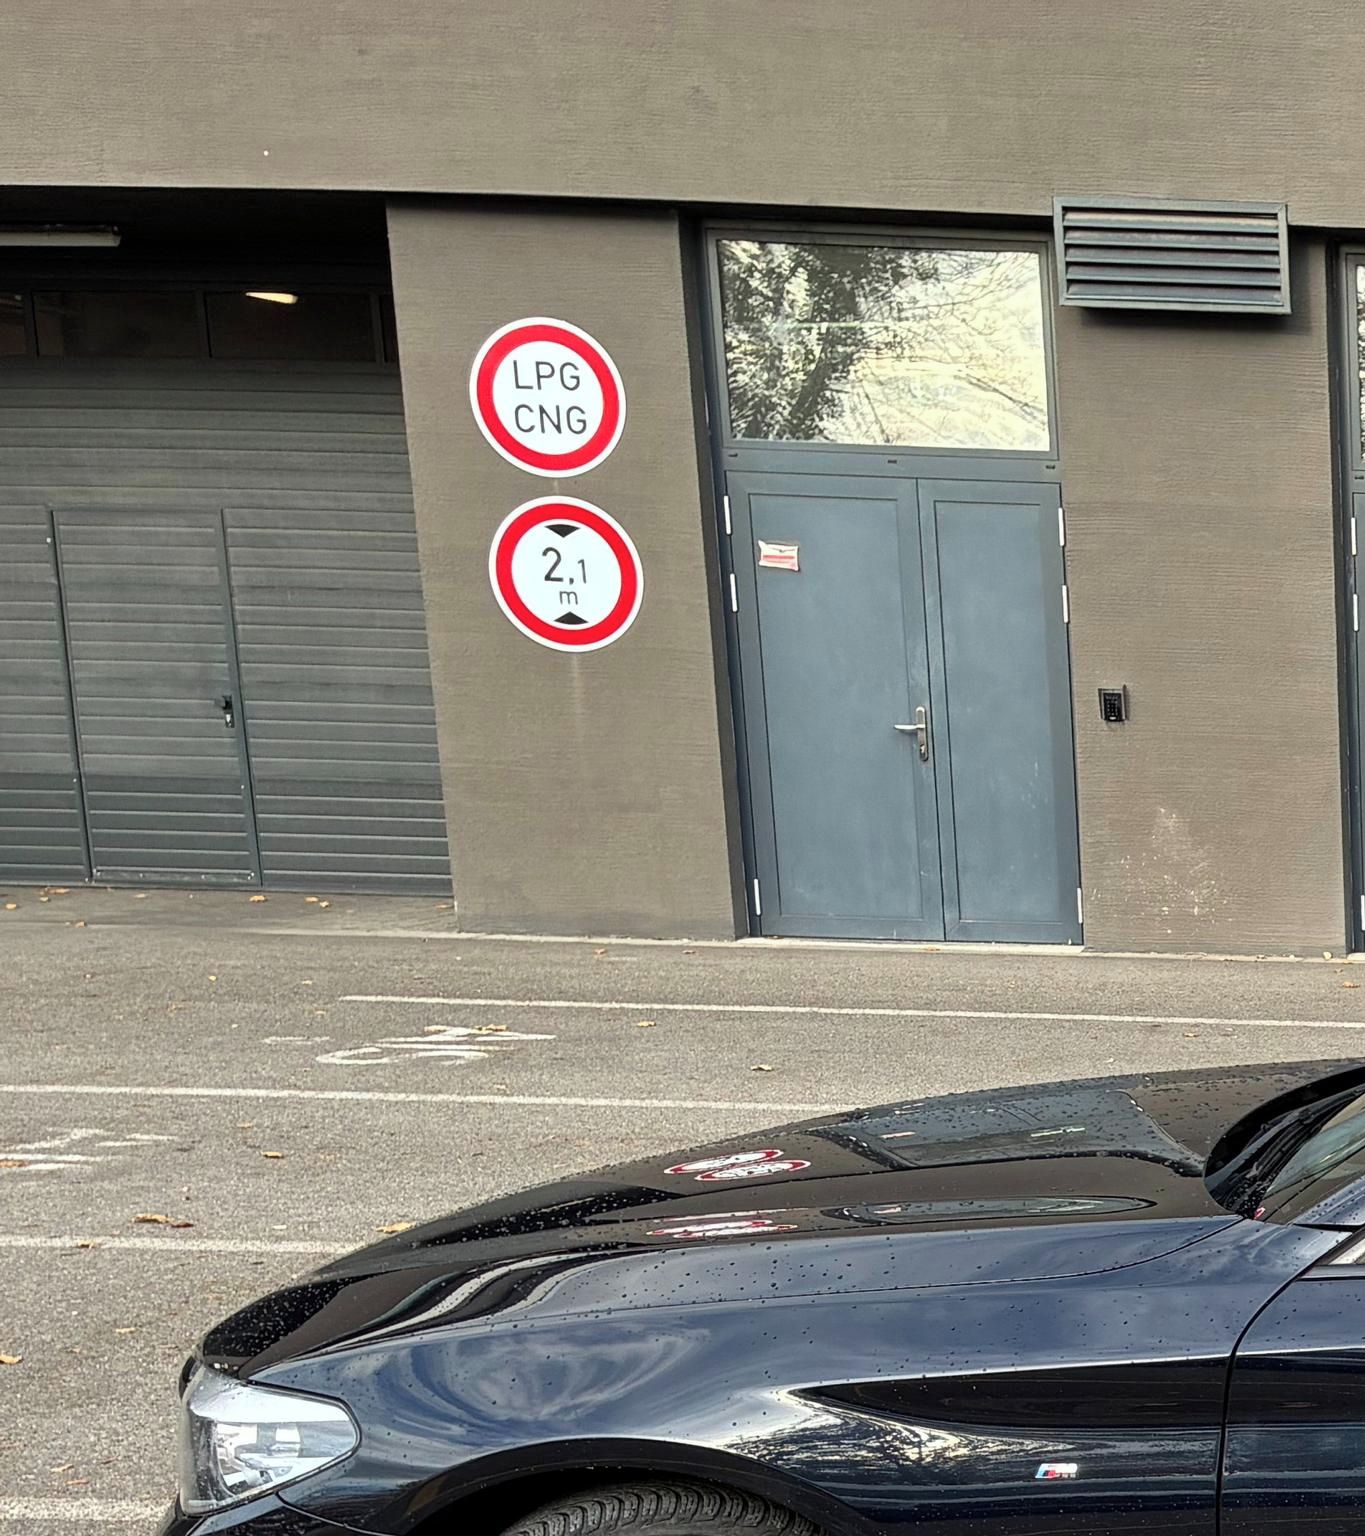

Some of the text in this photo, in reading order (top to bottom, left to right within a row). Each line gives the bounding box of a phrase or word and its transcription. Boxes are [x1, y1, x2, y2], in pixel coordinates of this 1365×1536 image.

[512, 359, 581, 391] LPG
[514, 403, 587, 435] CNG
[541, 546, 587, 586] 2,1
[558, 590, 579, 606] m
